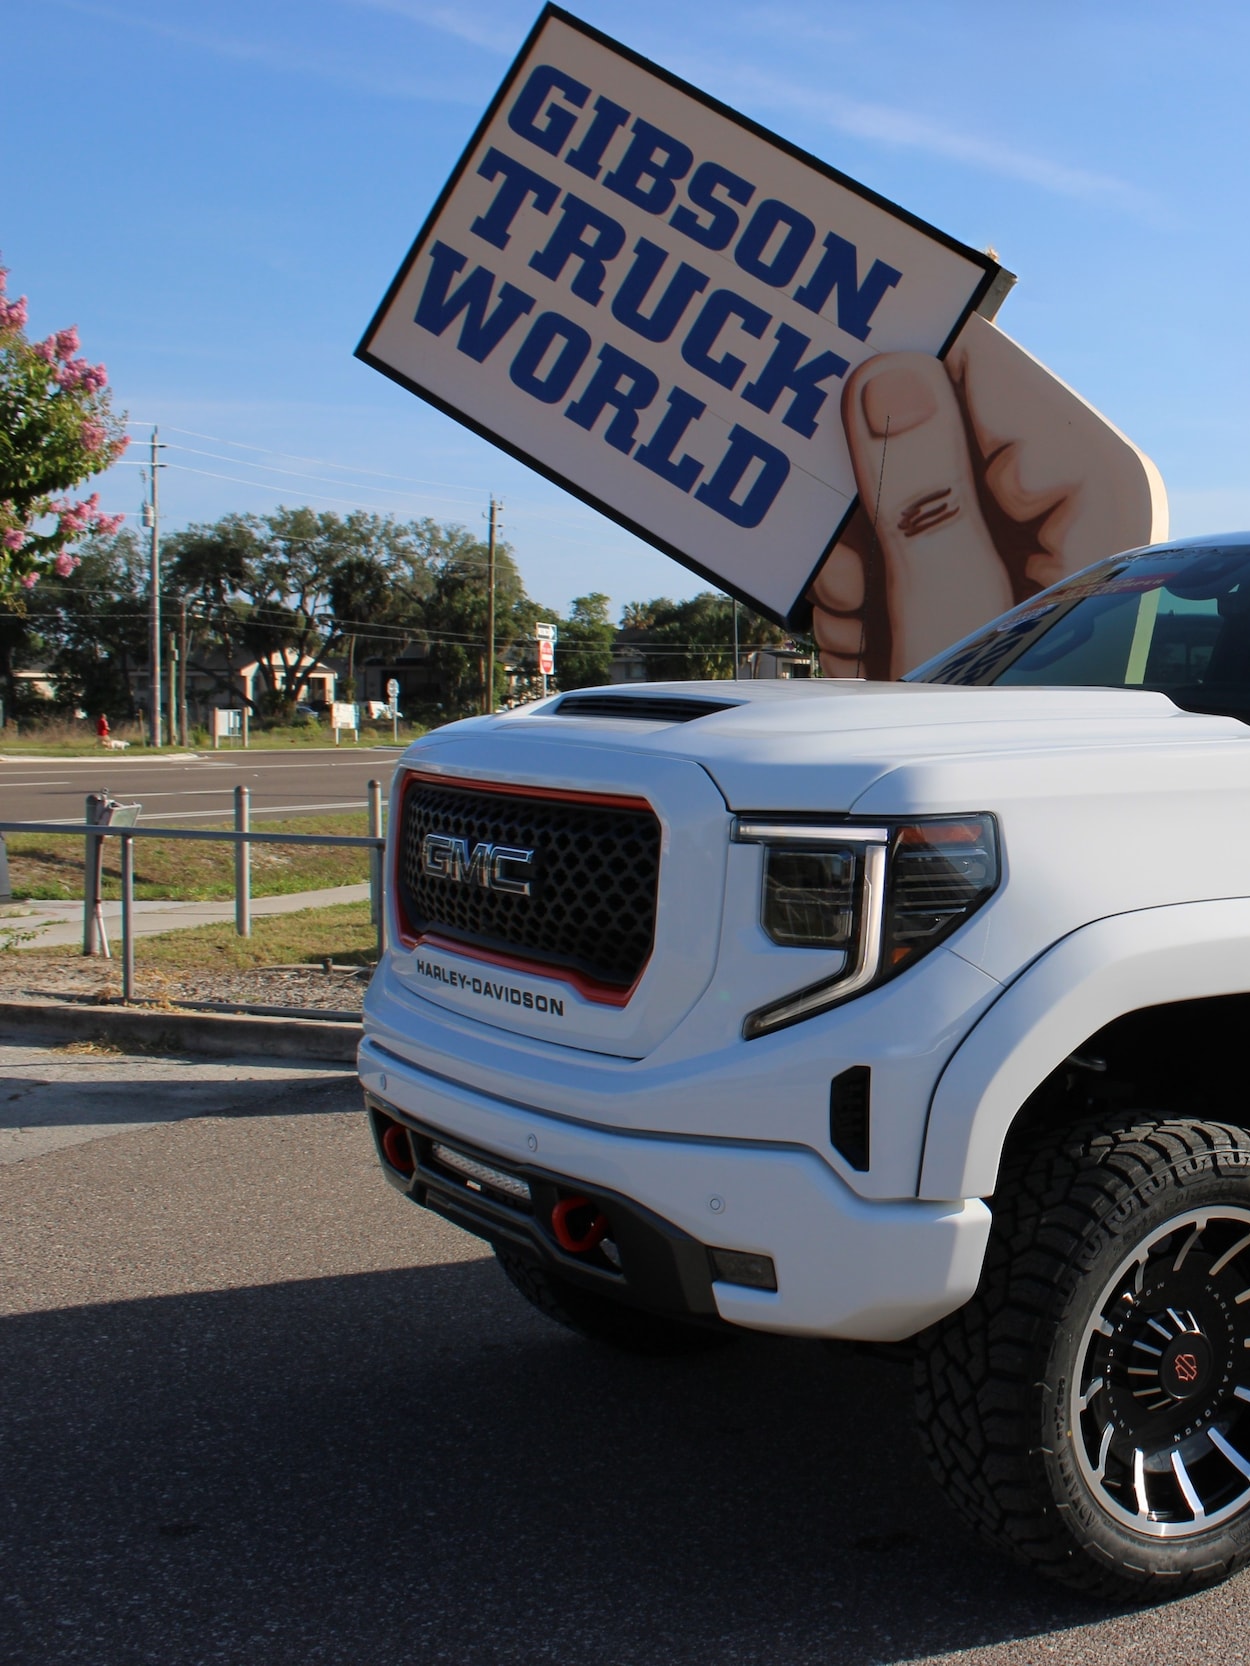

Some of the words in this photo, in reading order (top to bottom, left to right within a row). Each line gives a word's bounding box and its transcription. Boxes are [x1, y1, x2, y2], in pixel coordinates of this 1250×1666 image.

[470, 146, 851, 440] TRUCK
[507, 64, 903, 342] GIBSON
[413, 239, 791, 529] WORLD
[416, 958, 564, 1017] HARLEY-DAVIDSON
[422, 833, 534, 896] GMC
